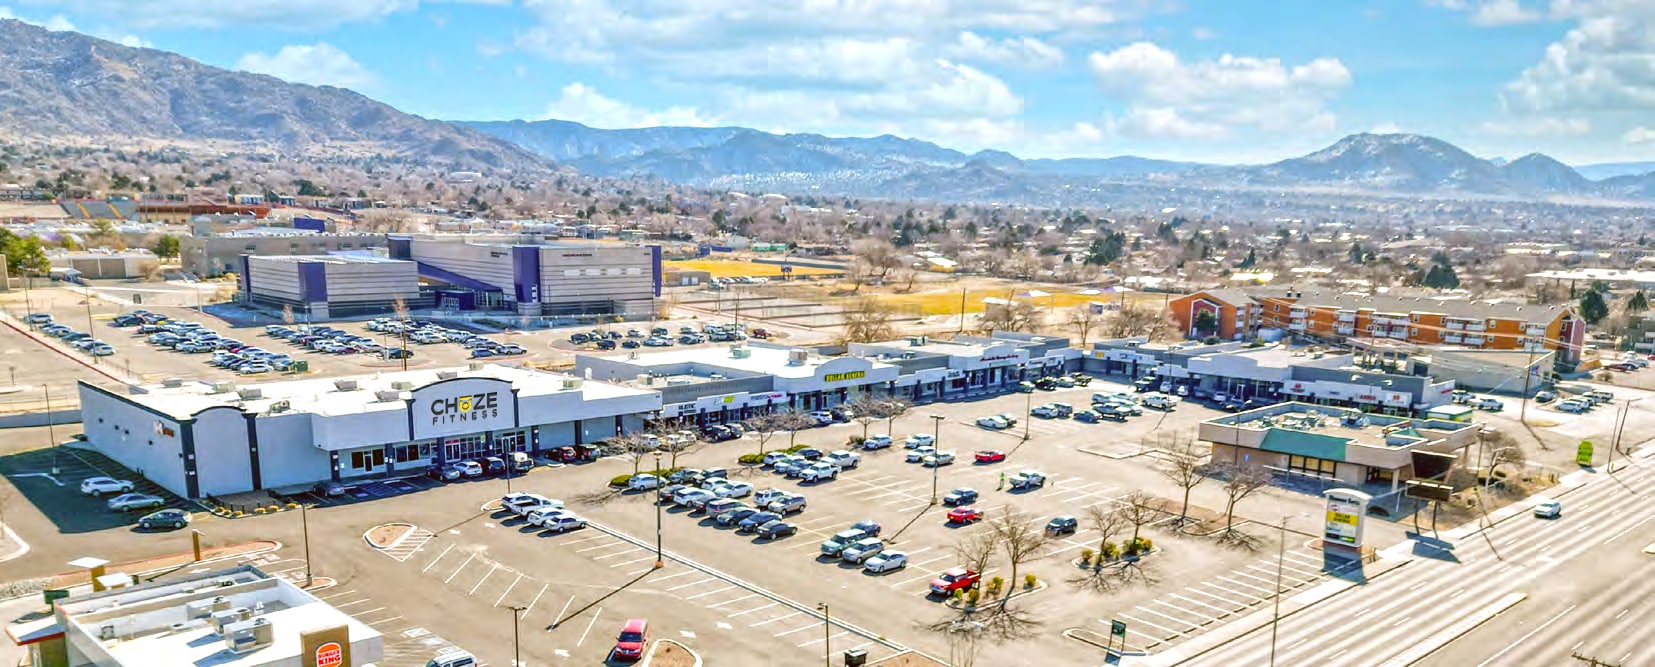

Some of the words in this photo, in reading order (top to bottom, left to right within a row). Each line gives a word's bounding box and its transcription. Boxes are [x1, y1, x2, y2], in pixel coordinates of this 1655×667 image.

[431, 392, 498, 415] CHUZE
[432, 408, 498, 426] FITNESS
[318, 650, 340, 658] BURGER
[319, 655, 341, 665] KING
